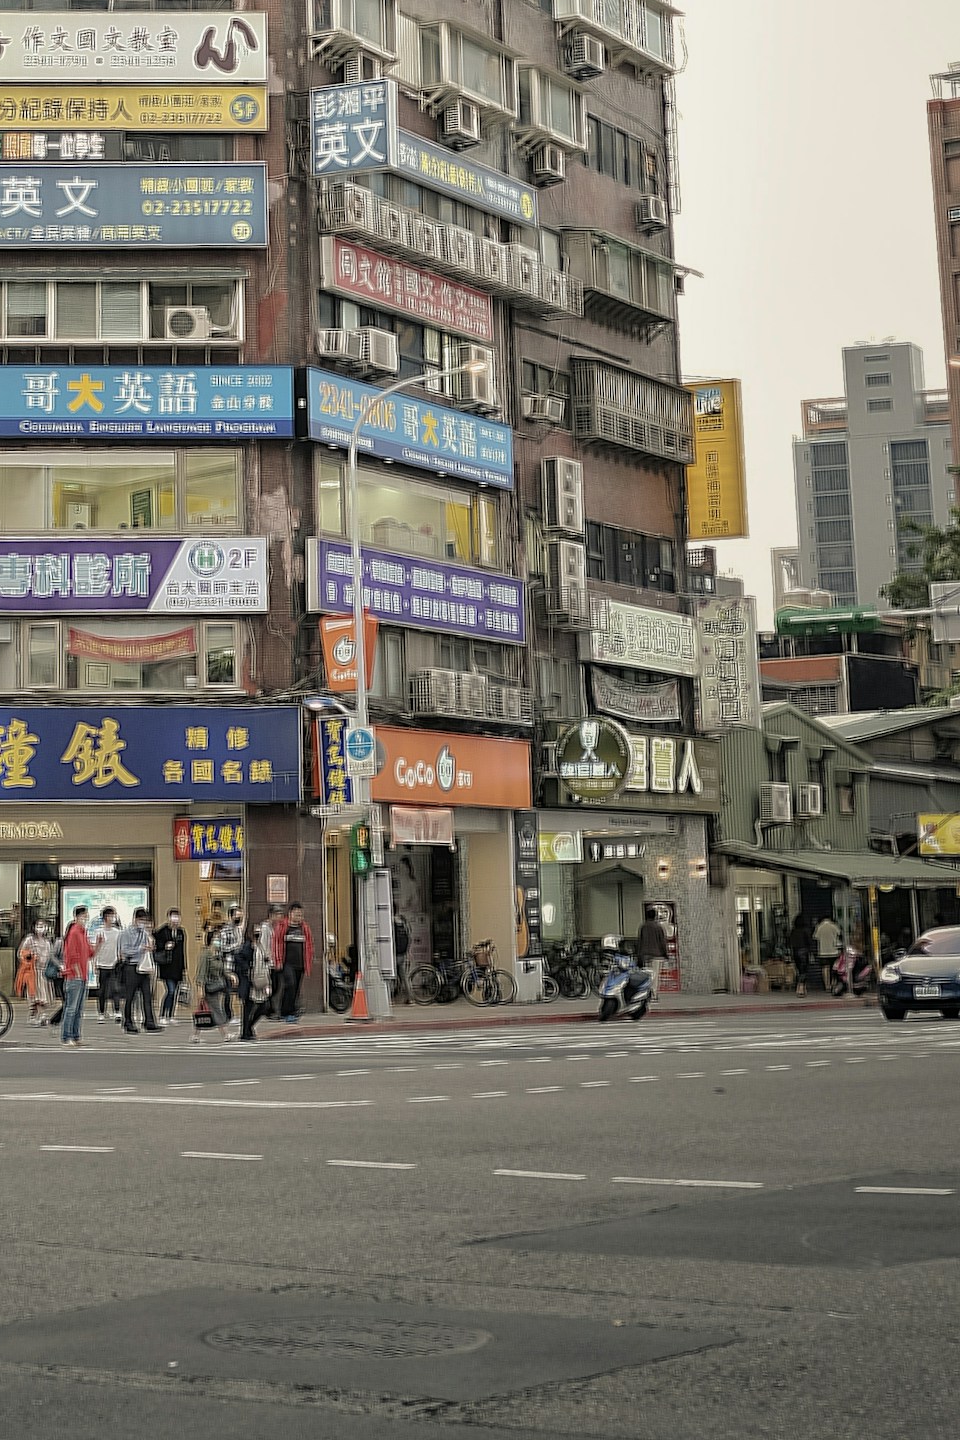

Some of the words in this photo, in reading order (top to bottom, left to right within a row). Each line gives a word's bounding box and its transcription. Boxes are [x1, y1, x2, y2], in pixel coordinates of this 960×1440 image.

[314, 85, 386, 121] 彭湘平
[315, 117, 386, 171] 英文
[21, 371, 200, 415] 哥大英語
[228, 548, 258, 569] 2F
